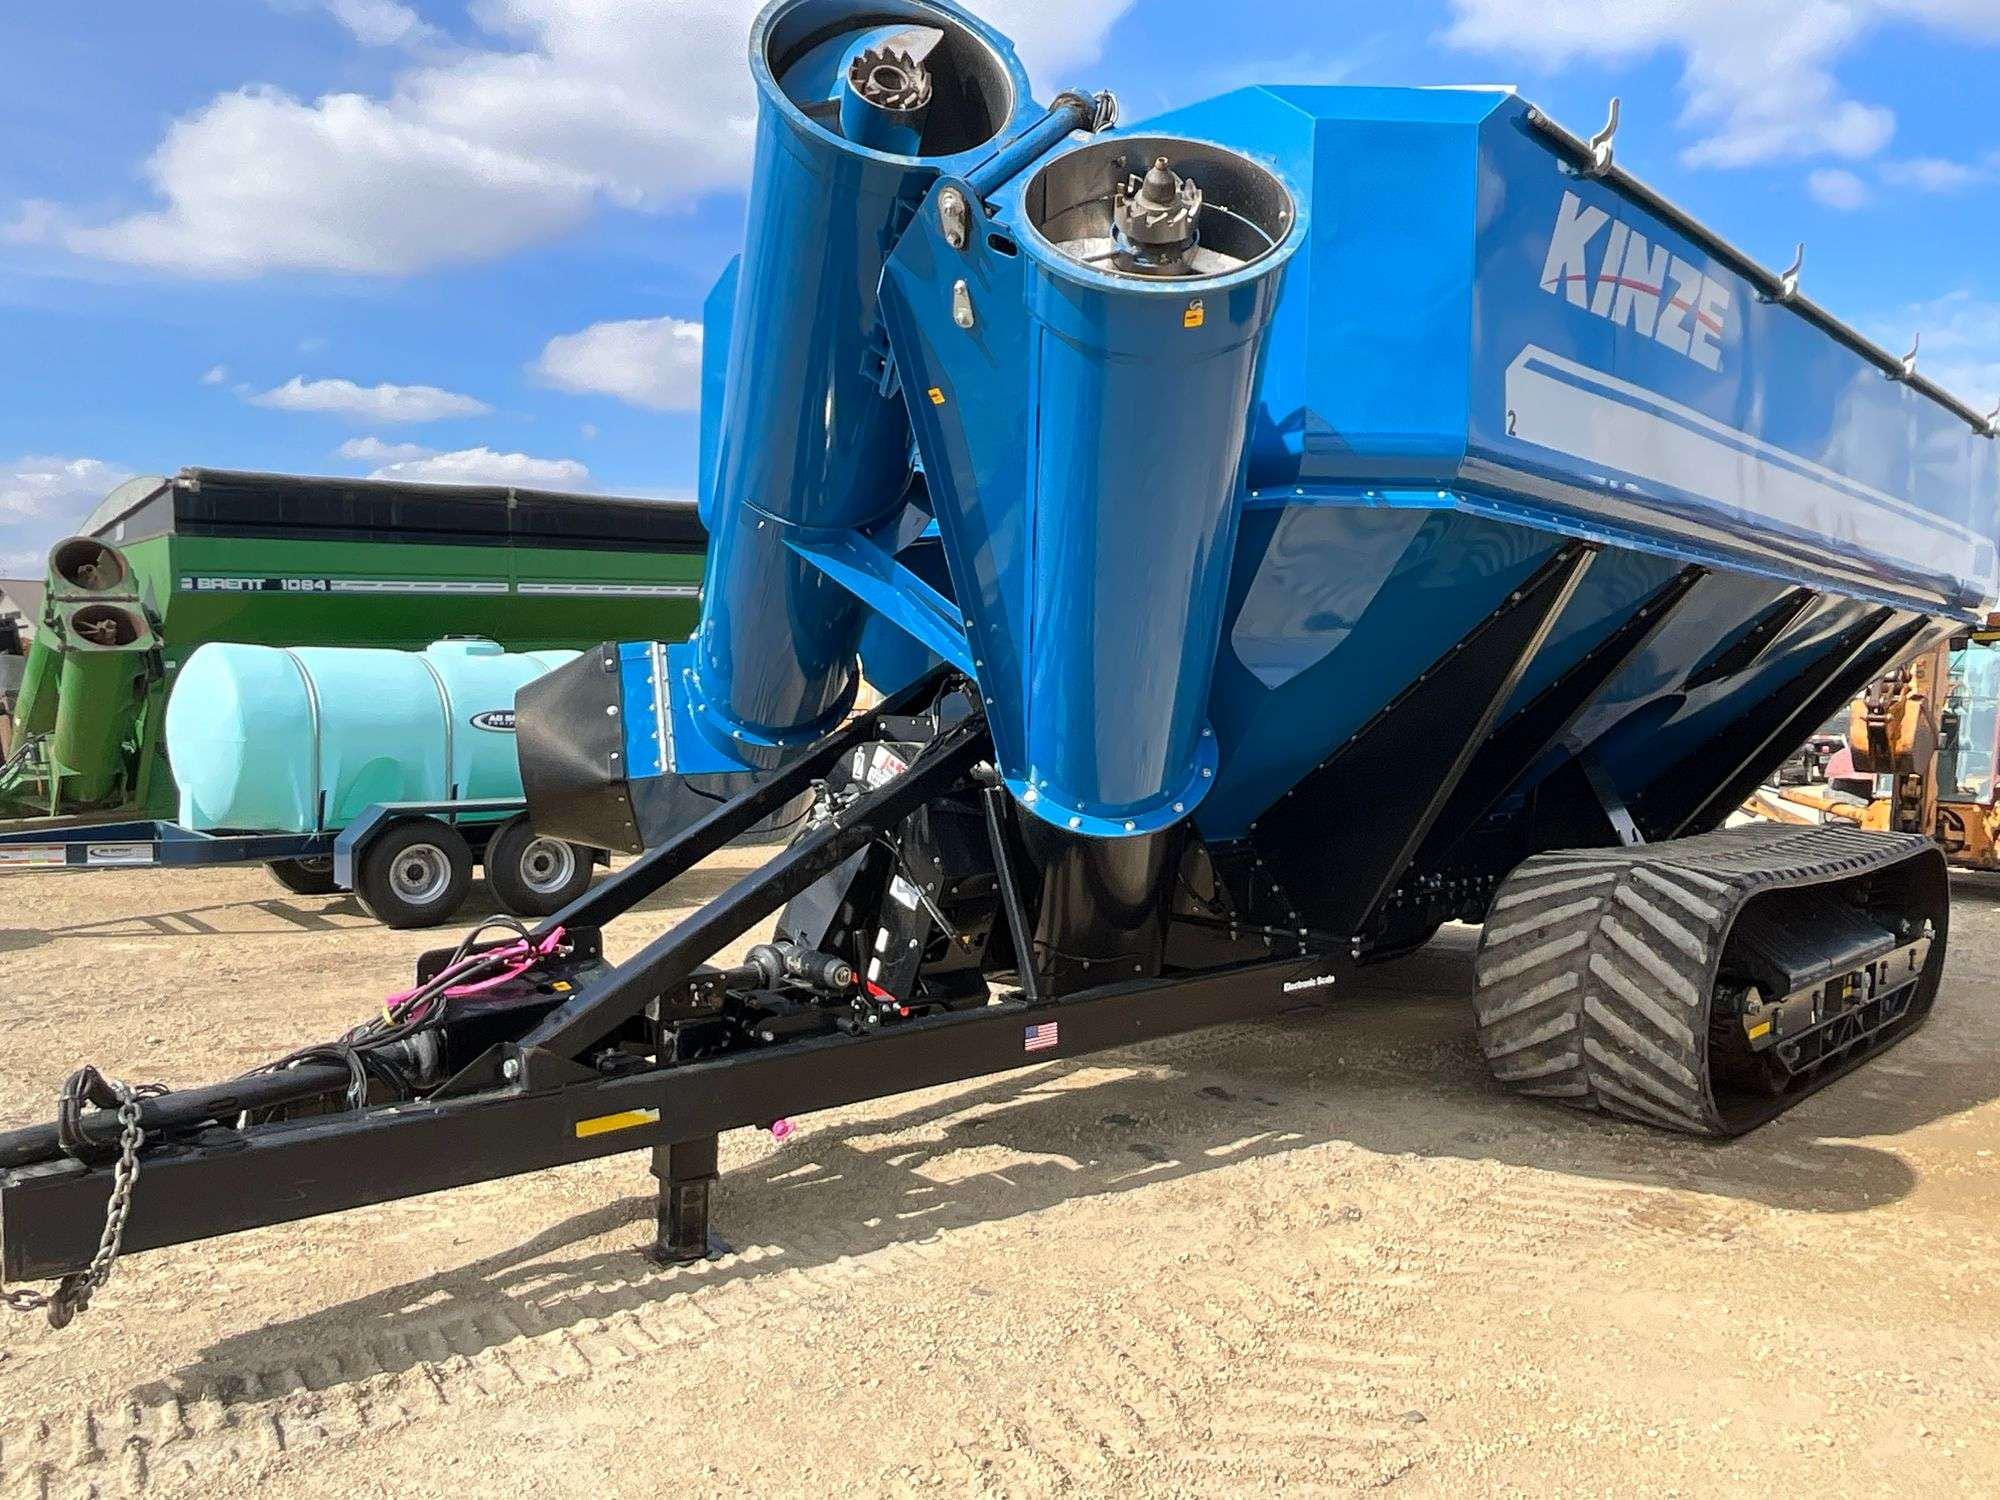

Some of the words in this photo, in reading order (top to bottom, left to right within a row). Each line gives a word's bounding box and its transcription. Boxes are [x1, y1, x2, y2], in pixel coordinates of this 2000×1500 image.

[1540, 190, 1730, 373] KINZE
[197, 578, 266, 591] BRENT
[280, 579, 327, 591] 1084
